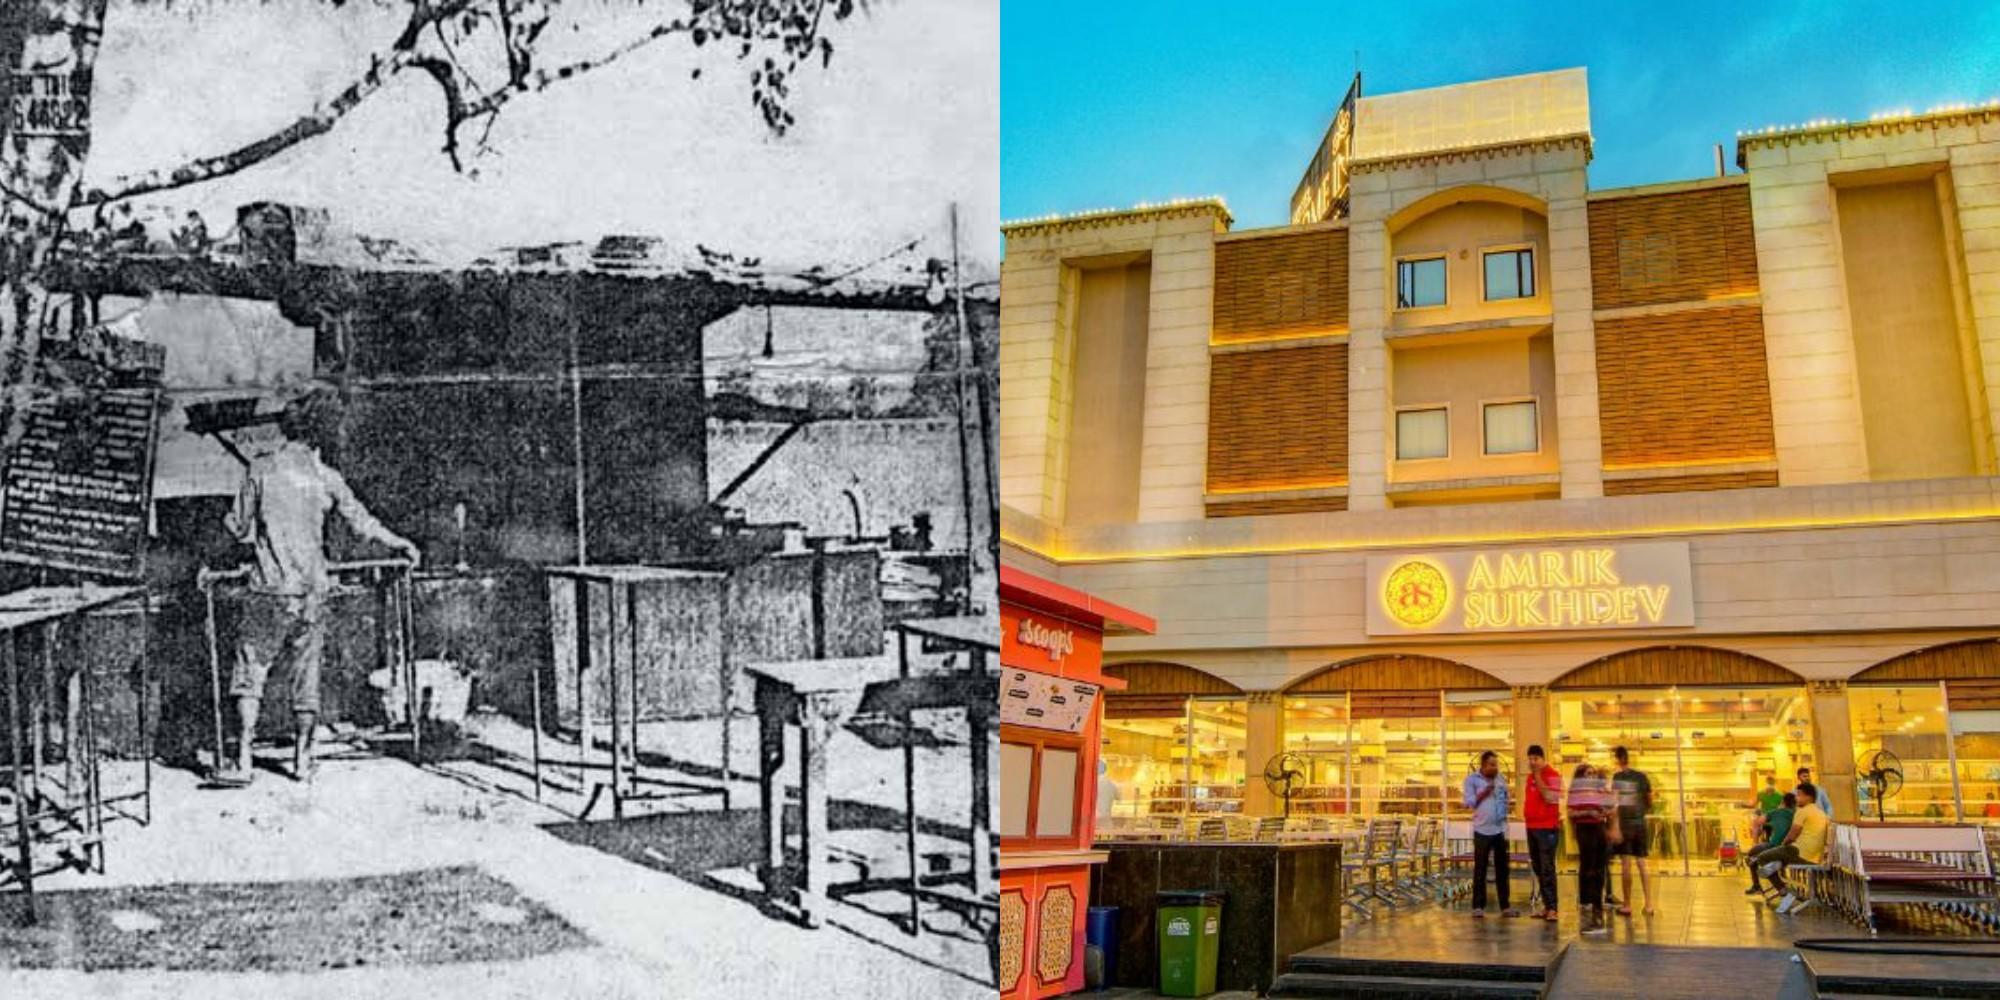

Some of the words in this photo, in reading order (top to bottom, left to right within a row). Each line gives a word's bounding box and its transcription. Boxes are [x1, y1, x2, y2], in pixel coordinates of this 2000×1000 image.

[1467, 550, 1619, 588] AMRIK
[1465, 585, 1669, 628] SUKHDEV
[1021, 618, 1074, 660] scoops
